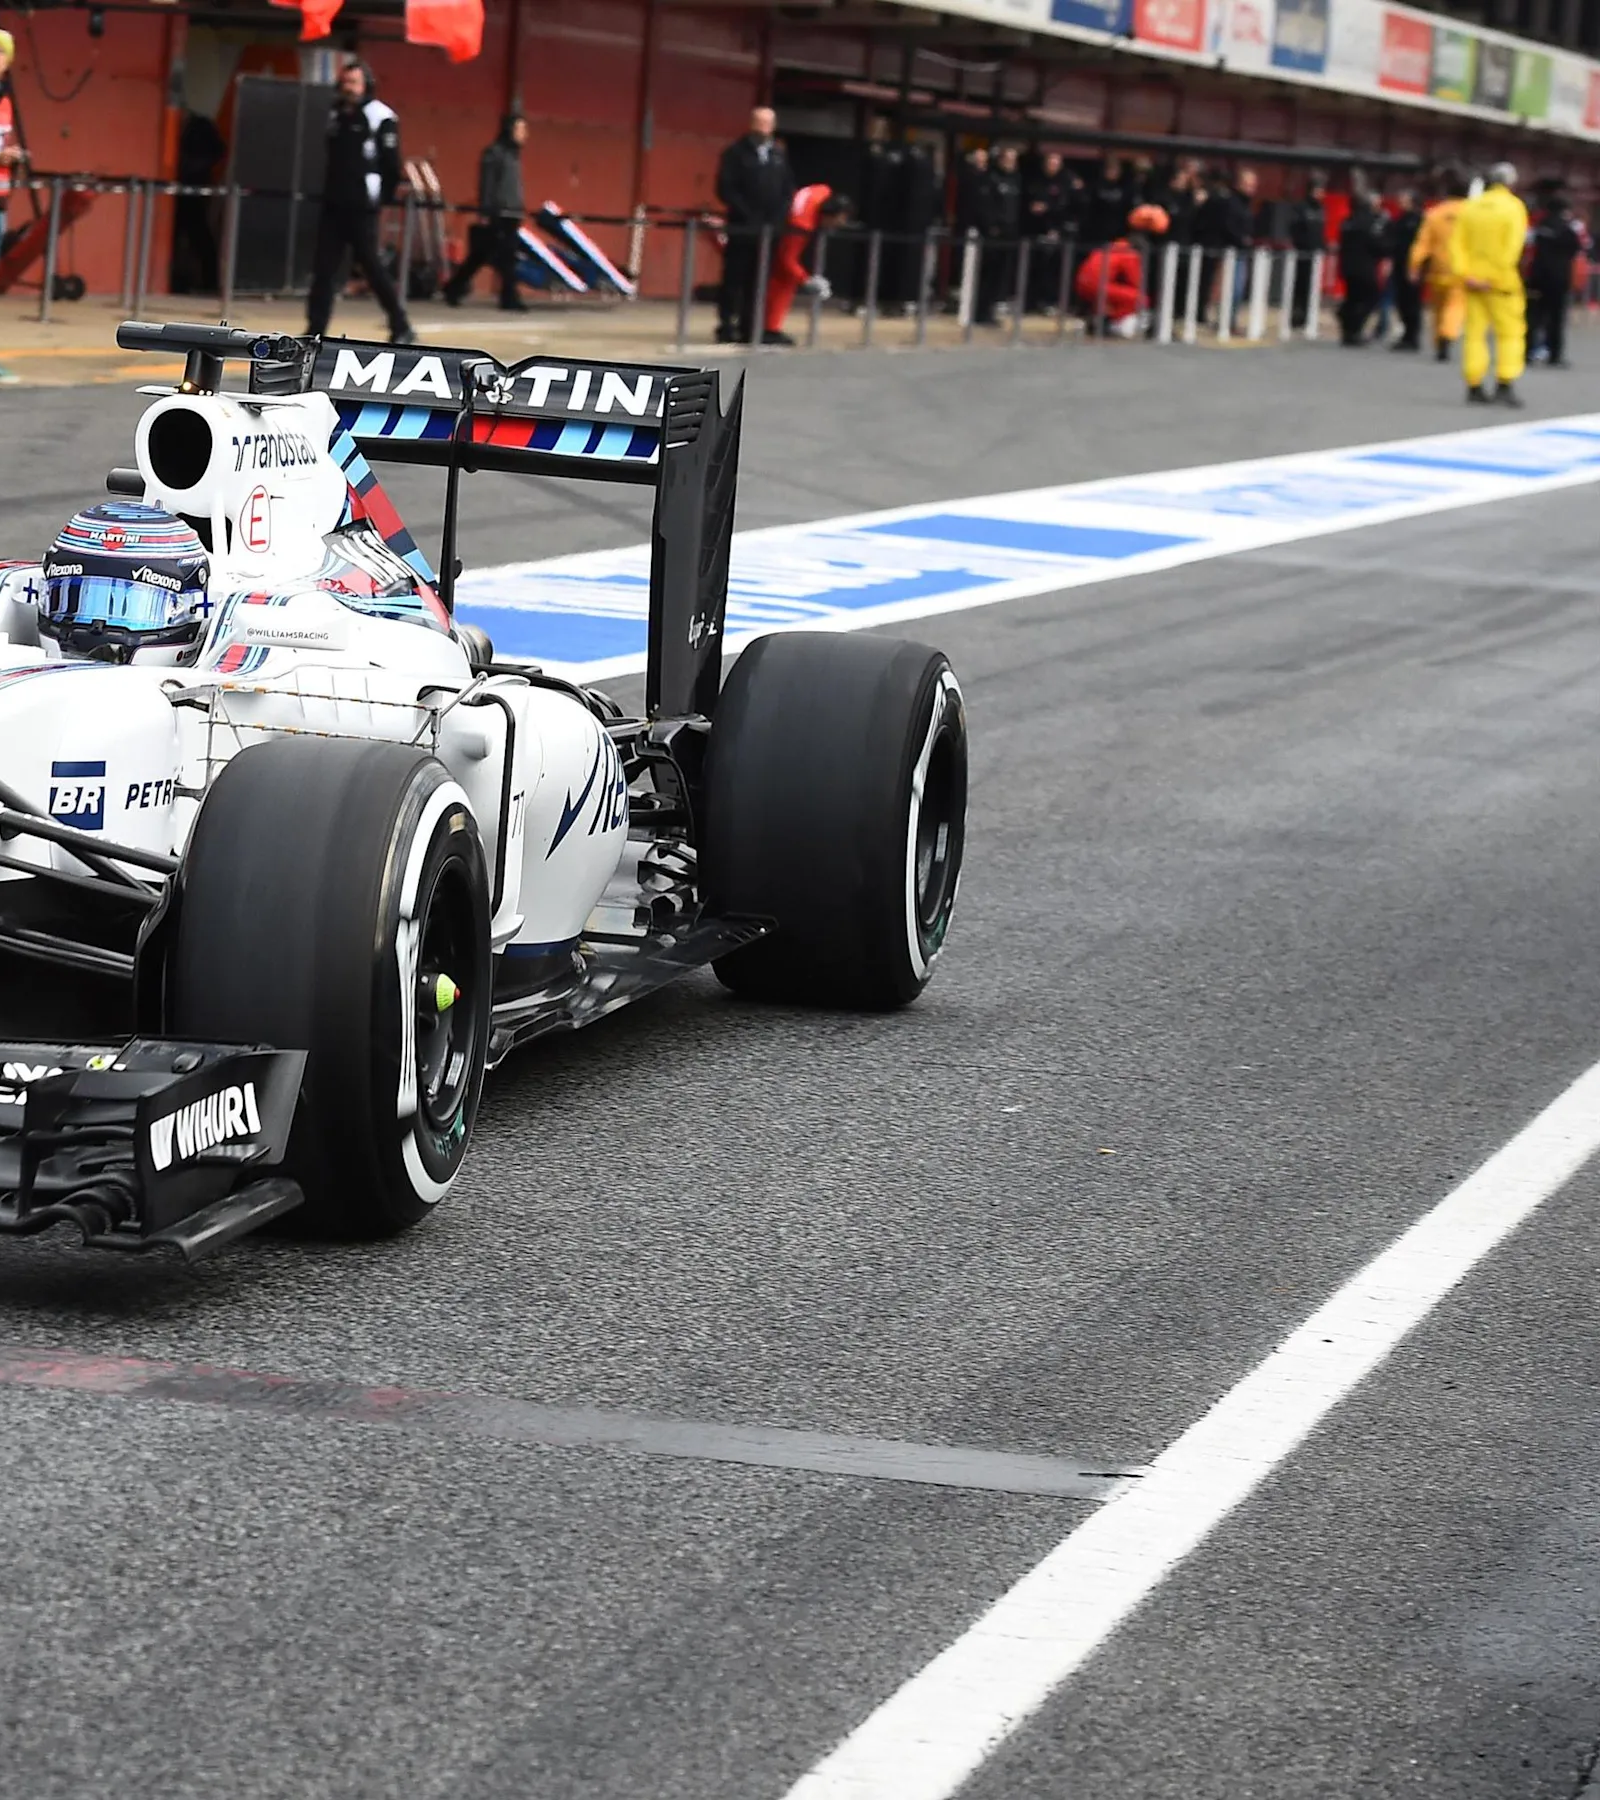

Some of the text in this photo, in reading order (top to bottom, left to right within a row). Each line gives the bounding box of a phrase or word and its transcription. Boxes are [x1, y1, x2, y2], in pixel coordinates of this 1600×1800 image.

[329, 349, 664, 418] MATIN
[250, 493, 267, 545] E
[90, 531, 141, 543] MARTINI
[50, 563, 83, 576] Rexona
[142, 567, 183, 592] Rexona
[247, 626, 330, 641] @WILLIAMSRACING
[51, 786, 102, 815] BR
[124, 779, 178, 810] PETR
